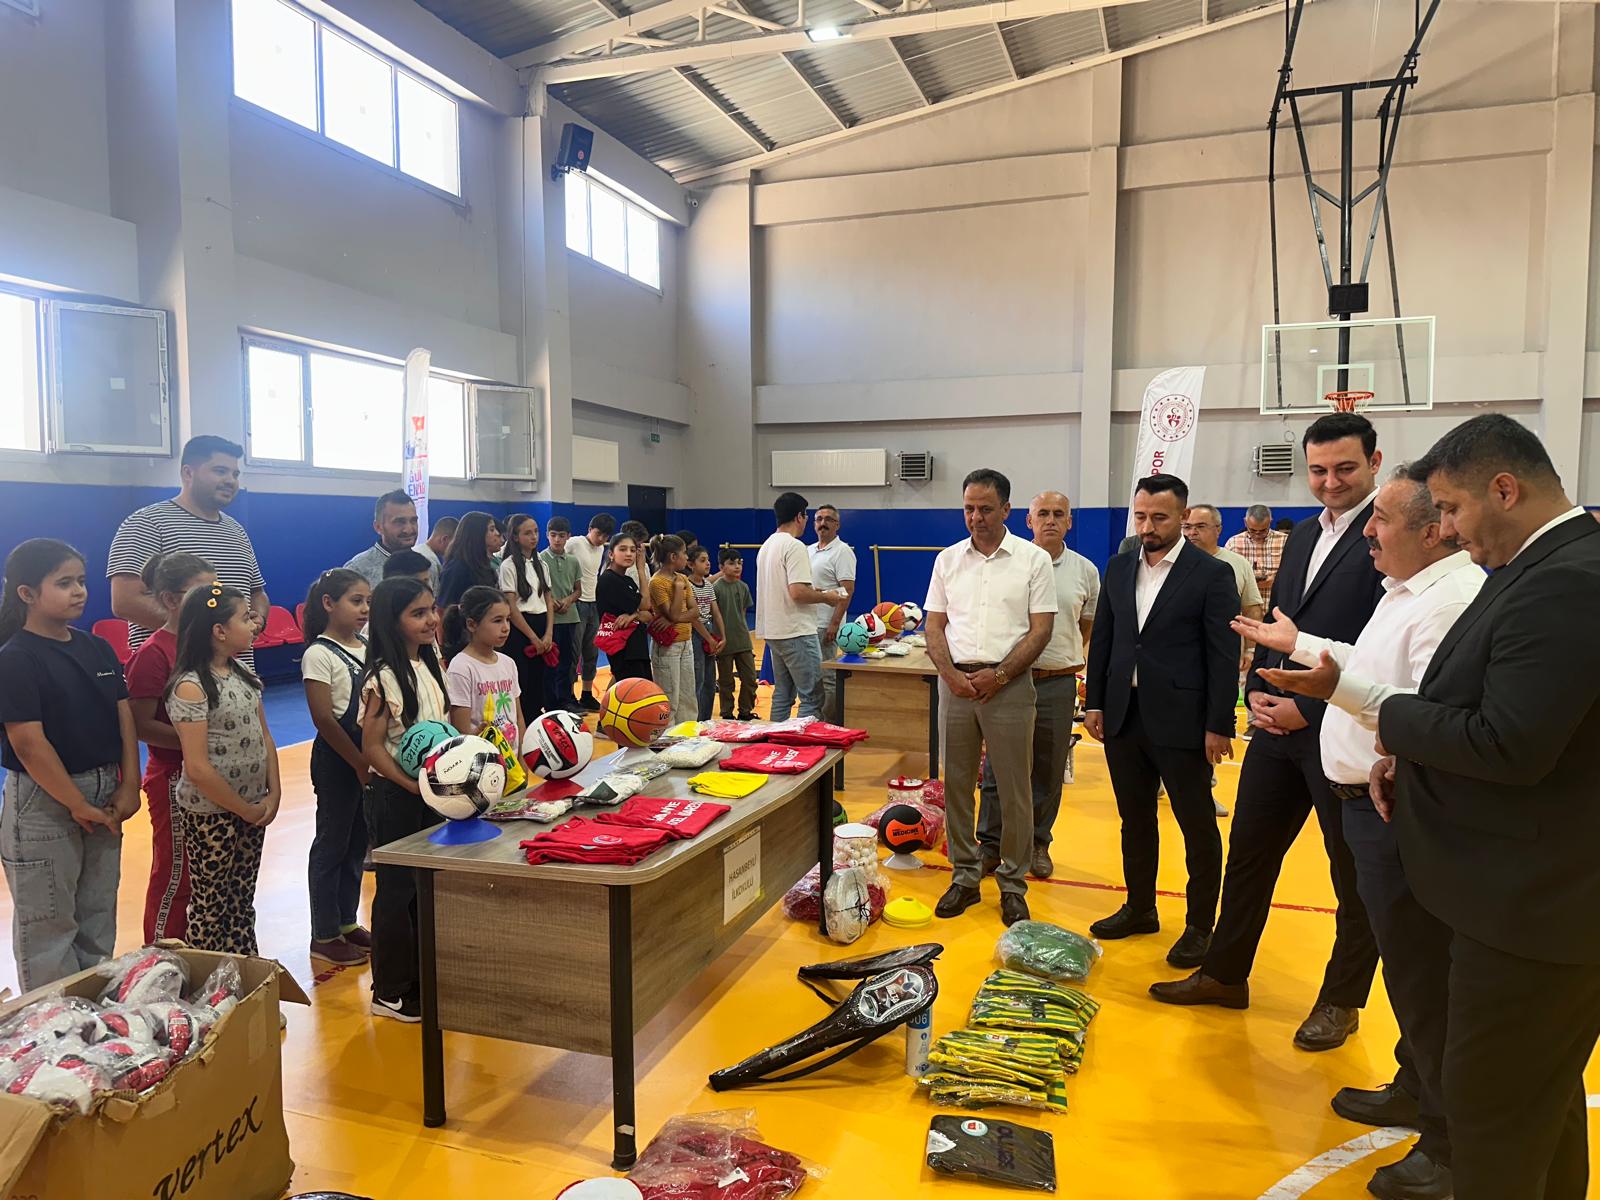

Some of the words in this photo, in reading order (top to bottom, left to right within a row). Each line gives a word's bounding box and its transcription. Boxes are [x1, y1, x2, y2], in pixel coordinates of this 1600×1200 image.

[1151, 450, 1165, 478] POR
[404, 734, 426, 765] vertex
[892, 827, 919, 837] MEDICINE
[153, 1096, 264, 1200] vertex
